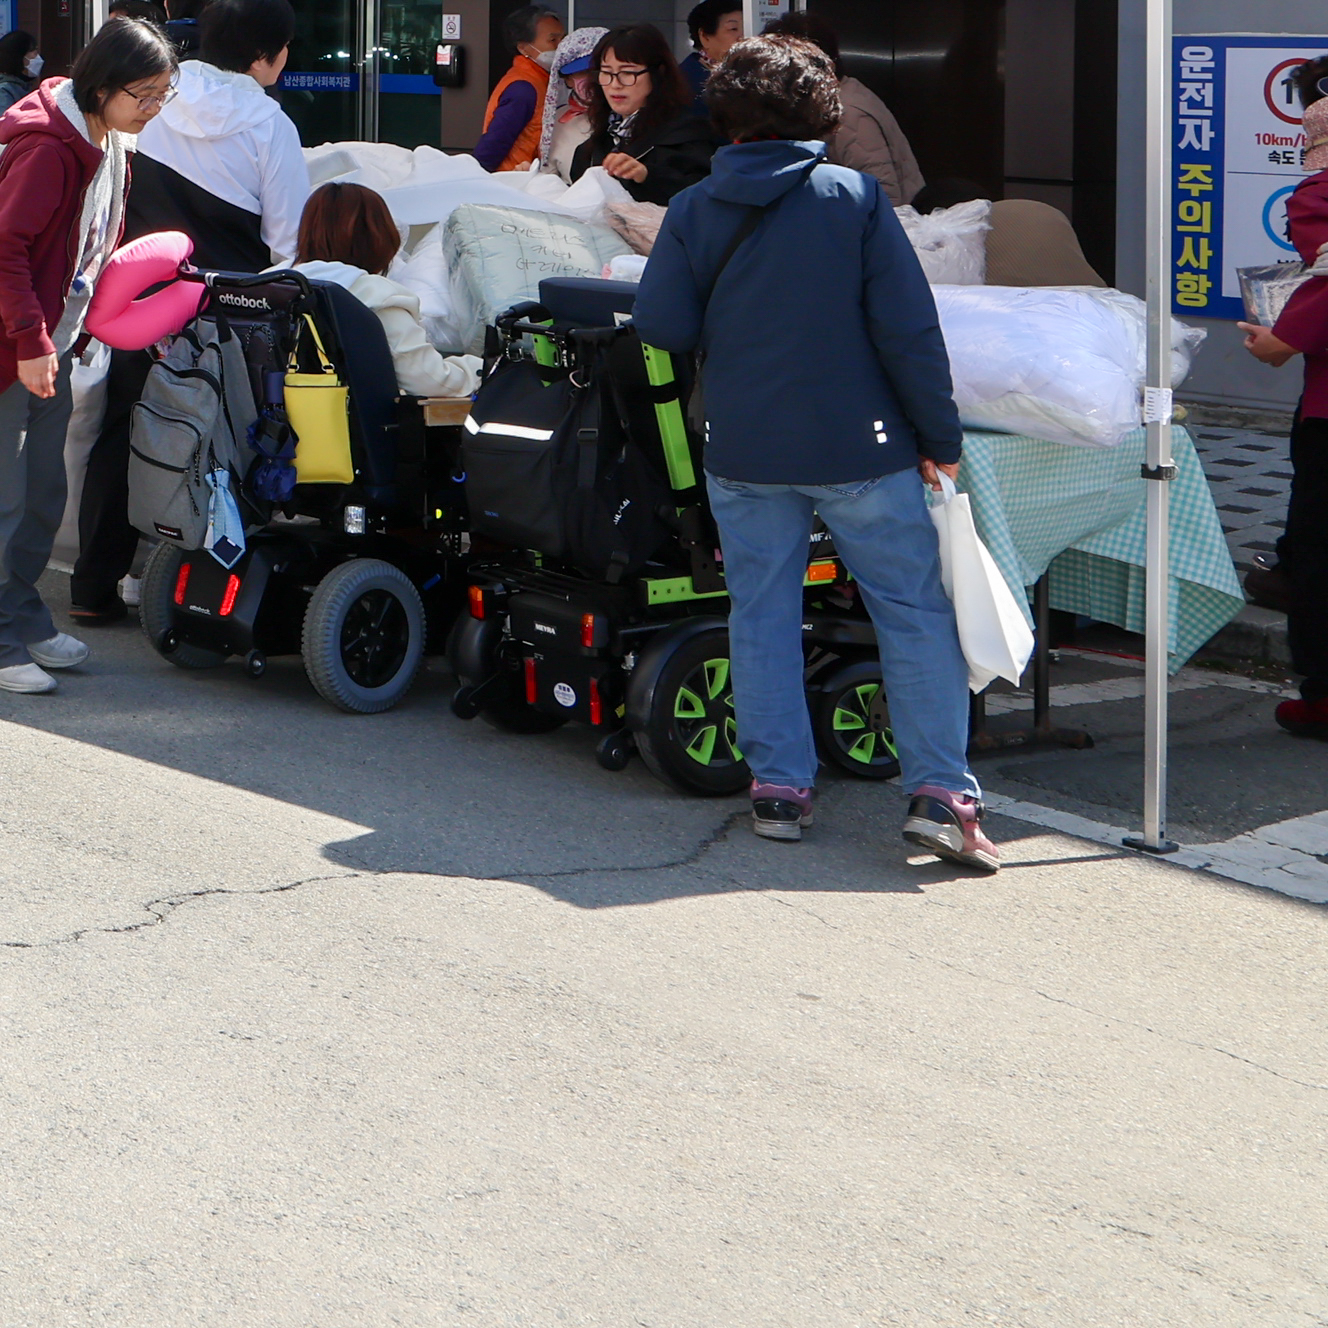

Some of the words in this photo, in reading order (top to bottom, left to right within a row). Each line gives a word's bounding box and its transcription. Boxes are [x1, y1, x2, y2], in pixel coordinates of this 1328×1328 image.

[1178, 46, 1215, 151] 운전자
[1268, 150, 1295, 165] 속도
[1176, 163, 1213, 308] 주의사항
[219, 293, 272, 310] ottobock
